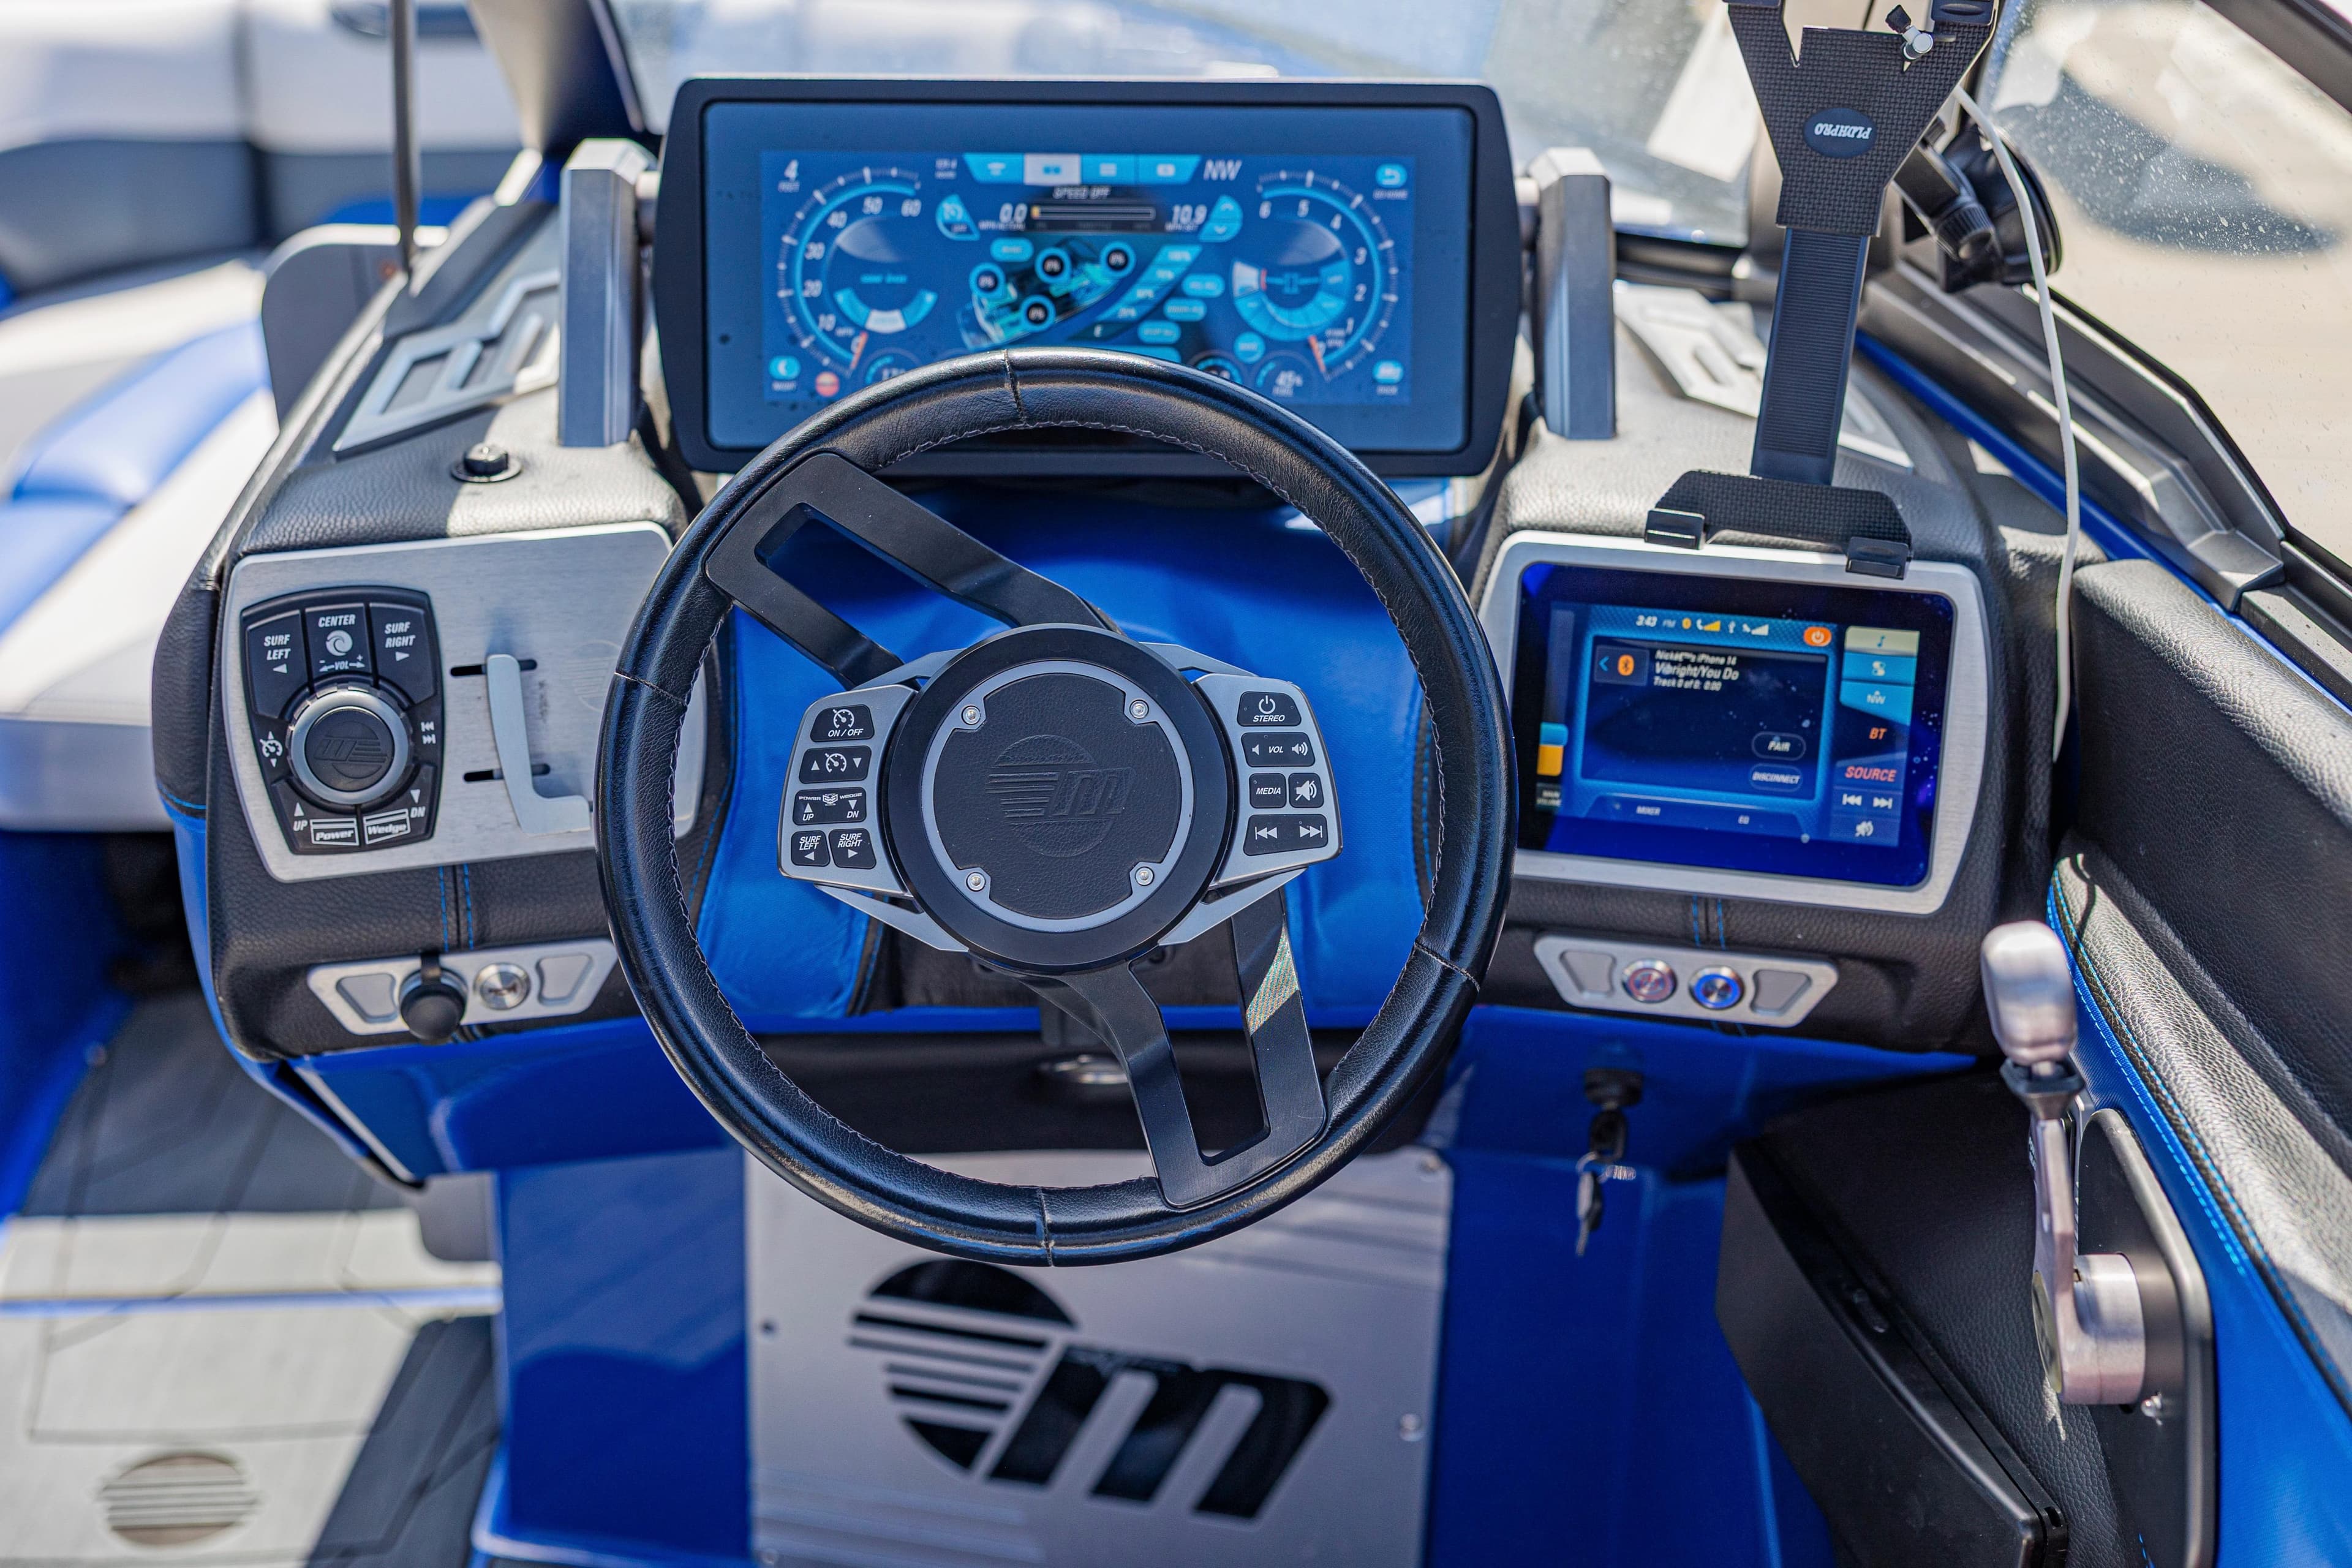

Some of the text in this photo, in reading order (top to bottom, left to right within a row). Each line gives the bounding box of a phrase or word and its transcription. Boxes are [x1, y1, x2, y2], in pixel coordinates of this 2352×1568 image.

[1203, 159, 1243, 181] NW
[862, 196, 883, 214] 50
[901, 198, 922, 217] 60
[1259, 200, 1272, 219] 6
[1297, 199, 1310, 217] 5
[827, 211, 848, 228] 40
[1171, 204, 1208, 225] 10.9
[1330, 213, 1342, 230] 4
[804, 242, 826, 260] 30
[1354, 247, 1367, 265] 3
[803, 279, 823, 297] 20
[1354, 284, 1366, 302] 2
[818, 314, 836, 331] 10
[1346, 317, 1354, 334] 1
[318, 614, 356, 628] CENTER
[385, 622, 411, 634] SURF
[264, 635, 291, 647] SURF
[385, 635, 415, 648] RIGHT
[266, 649, 291, 660] LEFT
[1697, 653, 1725, 665] iPhone
[334, 661, 349, 670] VOL
[1722, 667, 1740, 680] Do
[1654, 676, 1676, 687] Track
[1869, 727, 1887, 740] BT
[1768, 740, 1791, 752] PAIR
[1752, 771, 1801, 785] DISCONNECT
[1845, 766, 1897, 782] SOURCE
[411, 806, 426, 818] DN
[293, 820, 308, 832] UP
[368, 823, 407, 835] Wedge
[315, 829, 353, 841] Power
[799, 835, 821, 844] SURF
